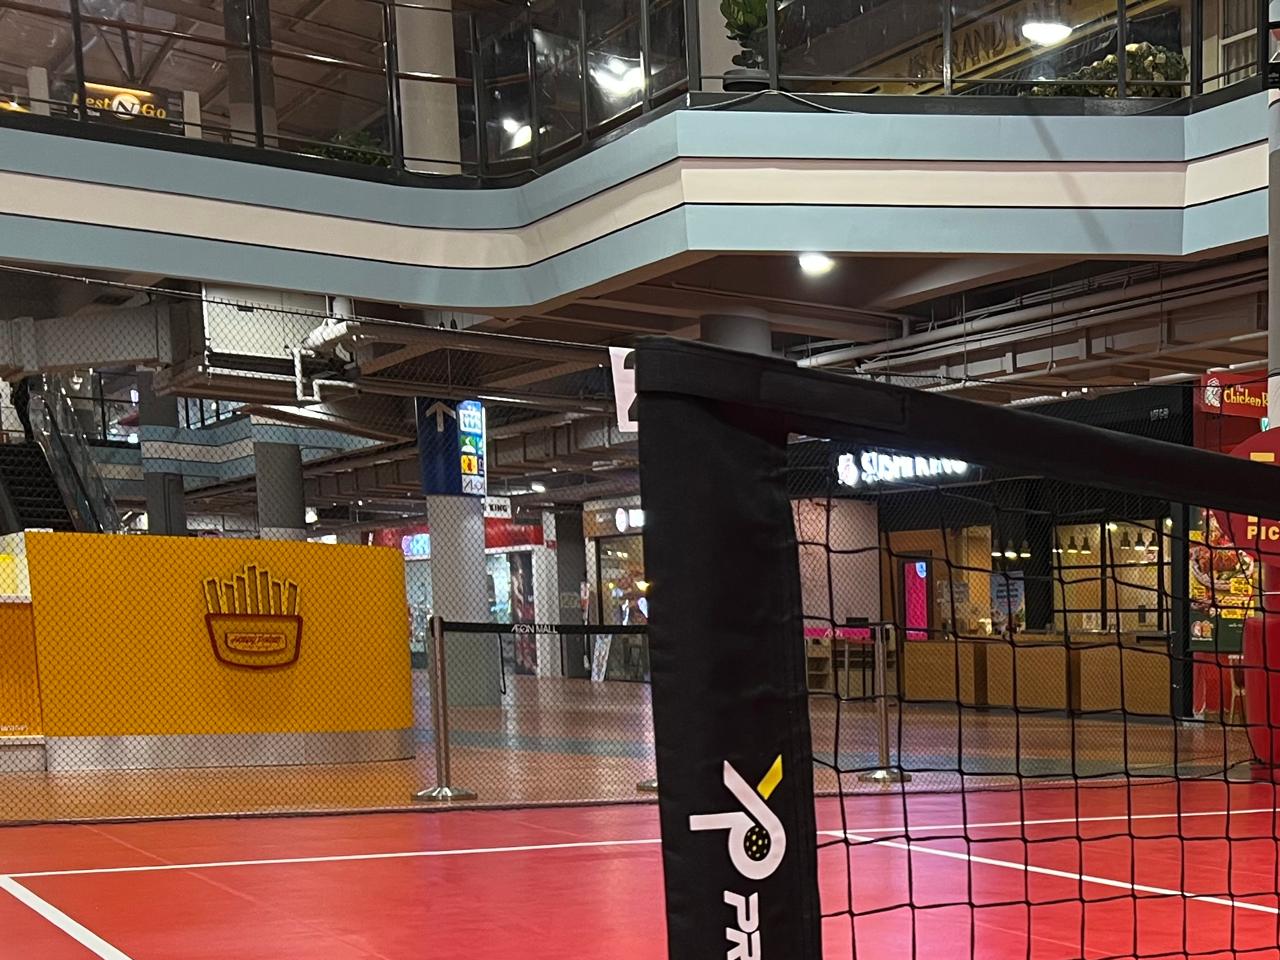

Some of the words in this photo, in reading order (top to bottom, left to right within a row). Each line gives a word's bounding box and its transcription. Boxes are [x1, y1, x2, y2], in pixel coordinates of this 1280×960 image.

[141, 103, 167, 119] Go
[1223, 388, 1262, 407] Chicken
[536, 624, 558, 634] MALL
